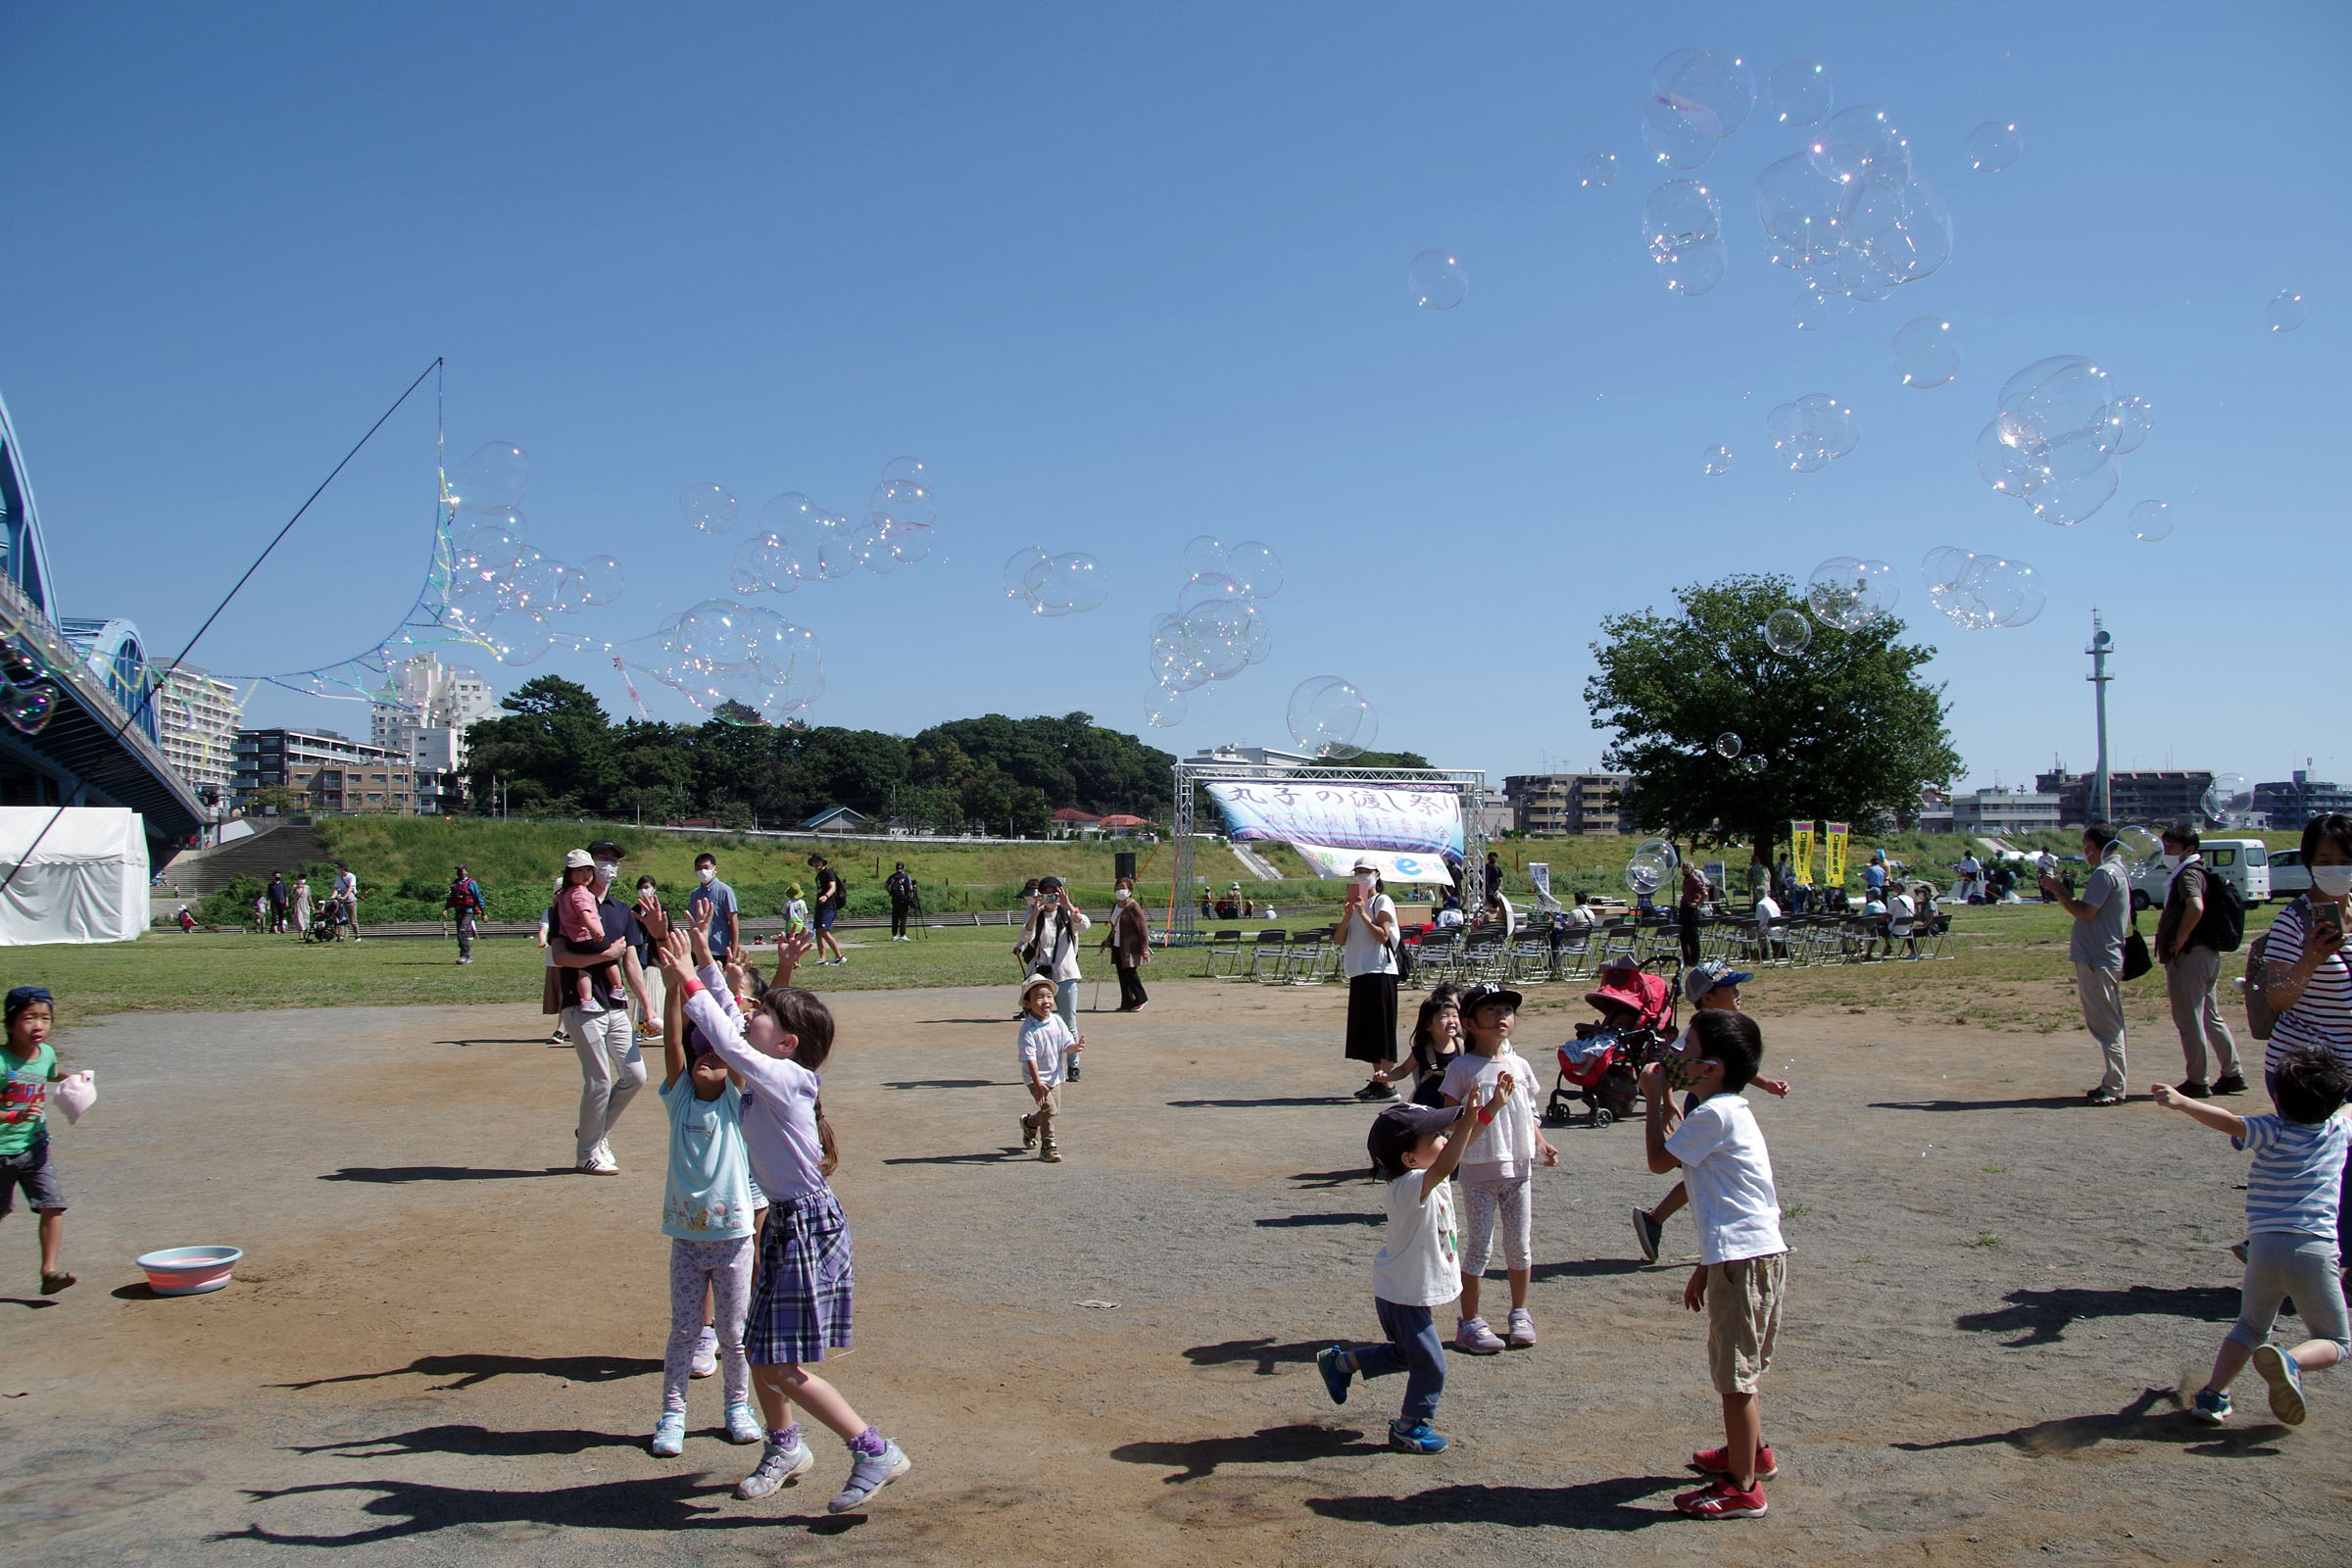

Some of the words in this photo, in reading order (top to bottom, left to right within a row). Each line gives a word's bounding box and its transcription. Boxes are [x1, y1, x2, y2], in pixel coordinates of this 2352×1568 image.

[1228, 786, 1459, 823] 丸子の渡し祭り
